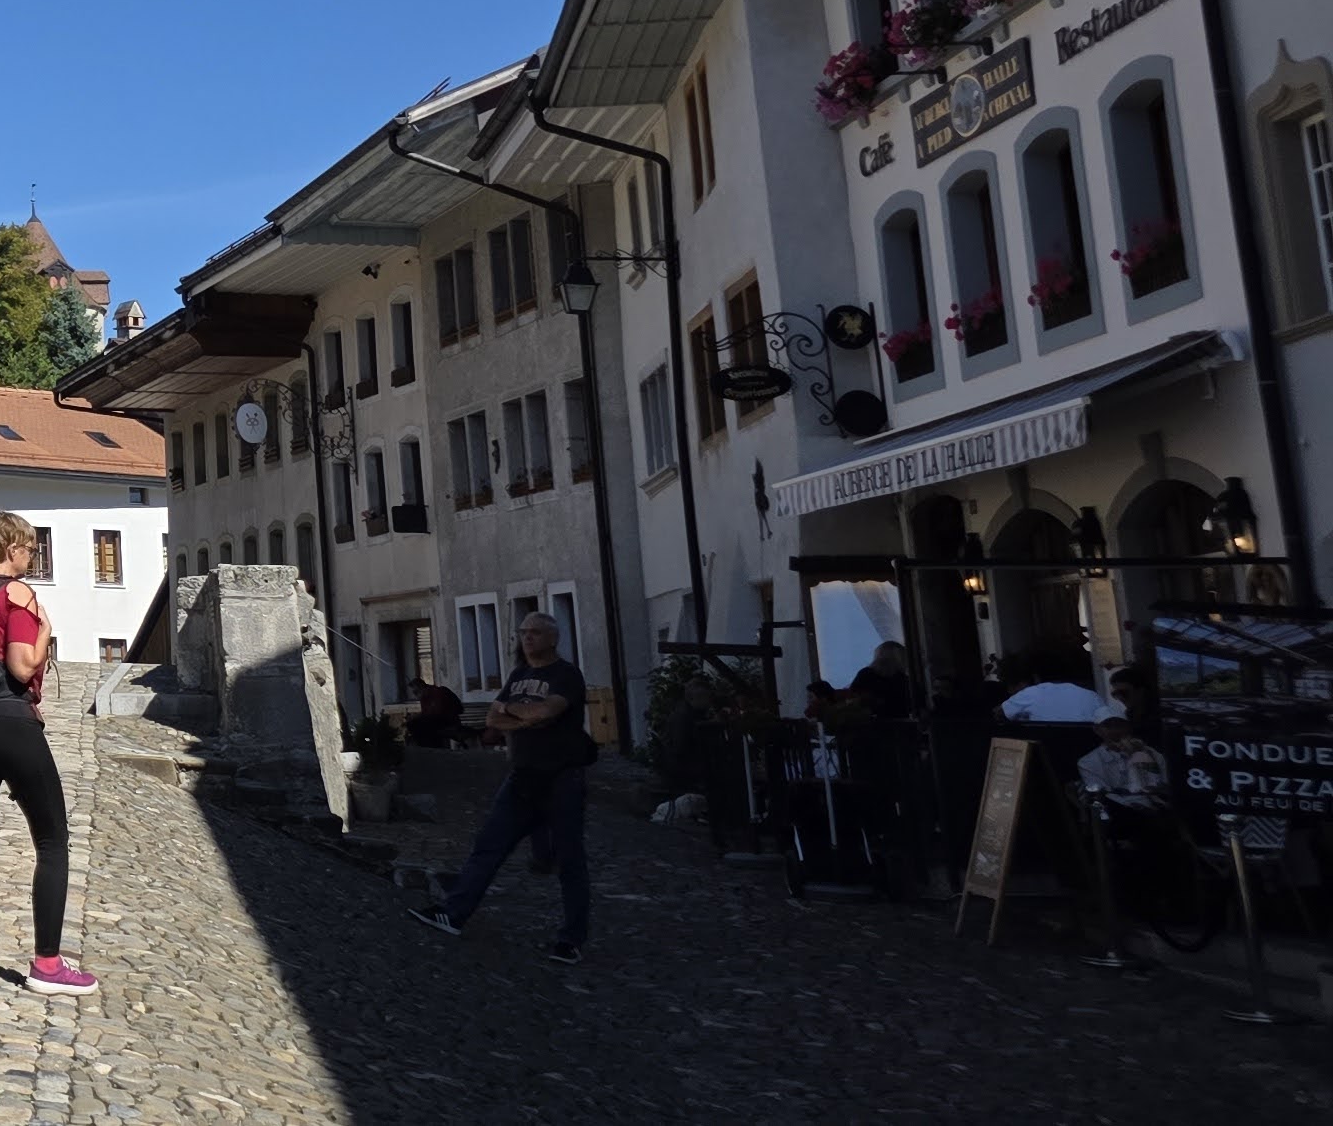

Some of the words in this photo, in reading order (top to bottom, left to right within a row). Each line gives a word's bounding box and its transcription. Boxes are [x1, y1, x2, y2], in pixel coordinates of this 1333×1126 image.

[859, 132, 895, 177] Café
[833, 461, 891, 500] AUBERGE
[895, 455, 915, 485] DE
[920, 449, 939, 478] LA
[1183, 735, 1333, 765] FONDUE
[1186, 768, 1213, 790] &
[1214, 794, 1240, 806] AU
[1251, 797, 1289, 809] FEU
[1299, 799, 1325, 812] DE
